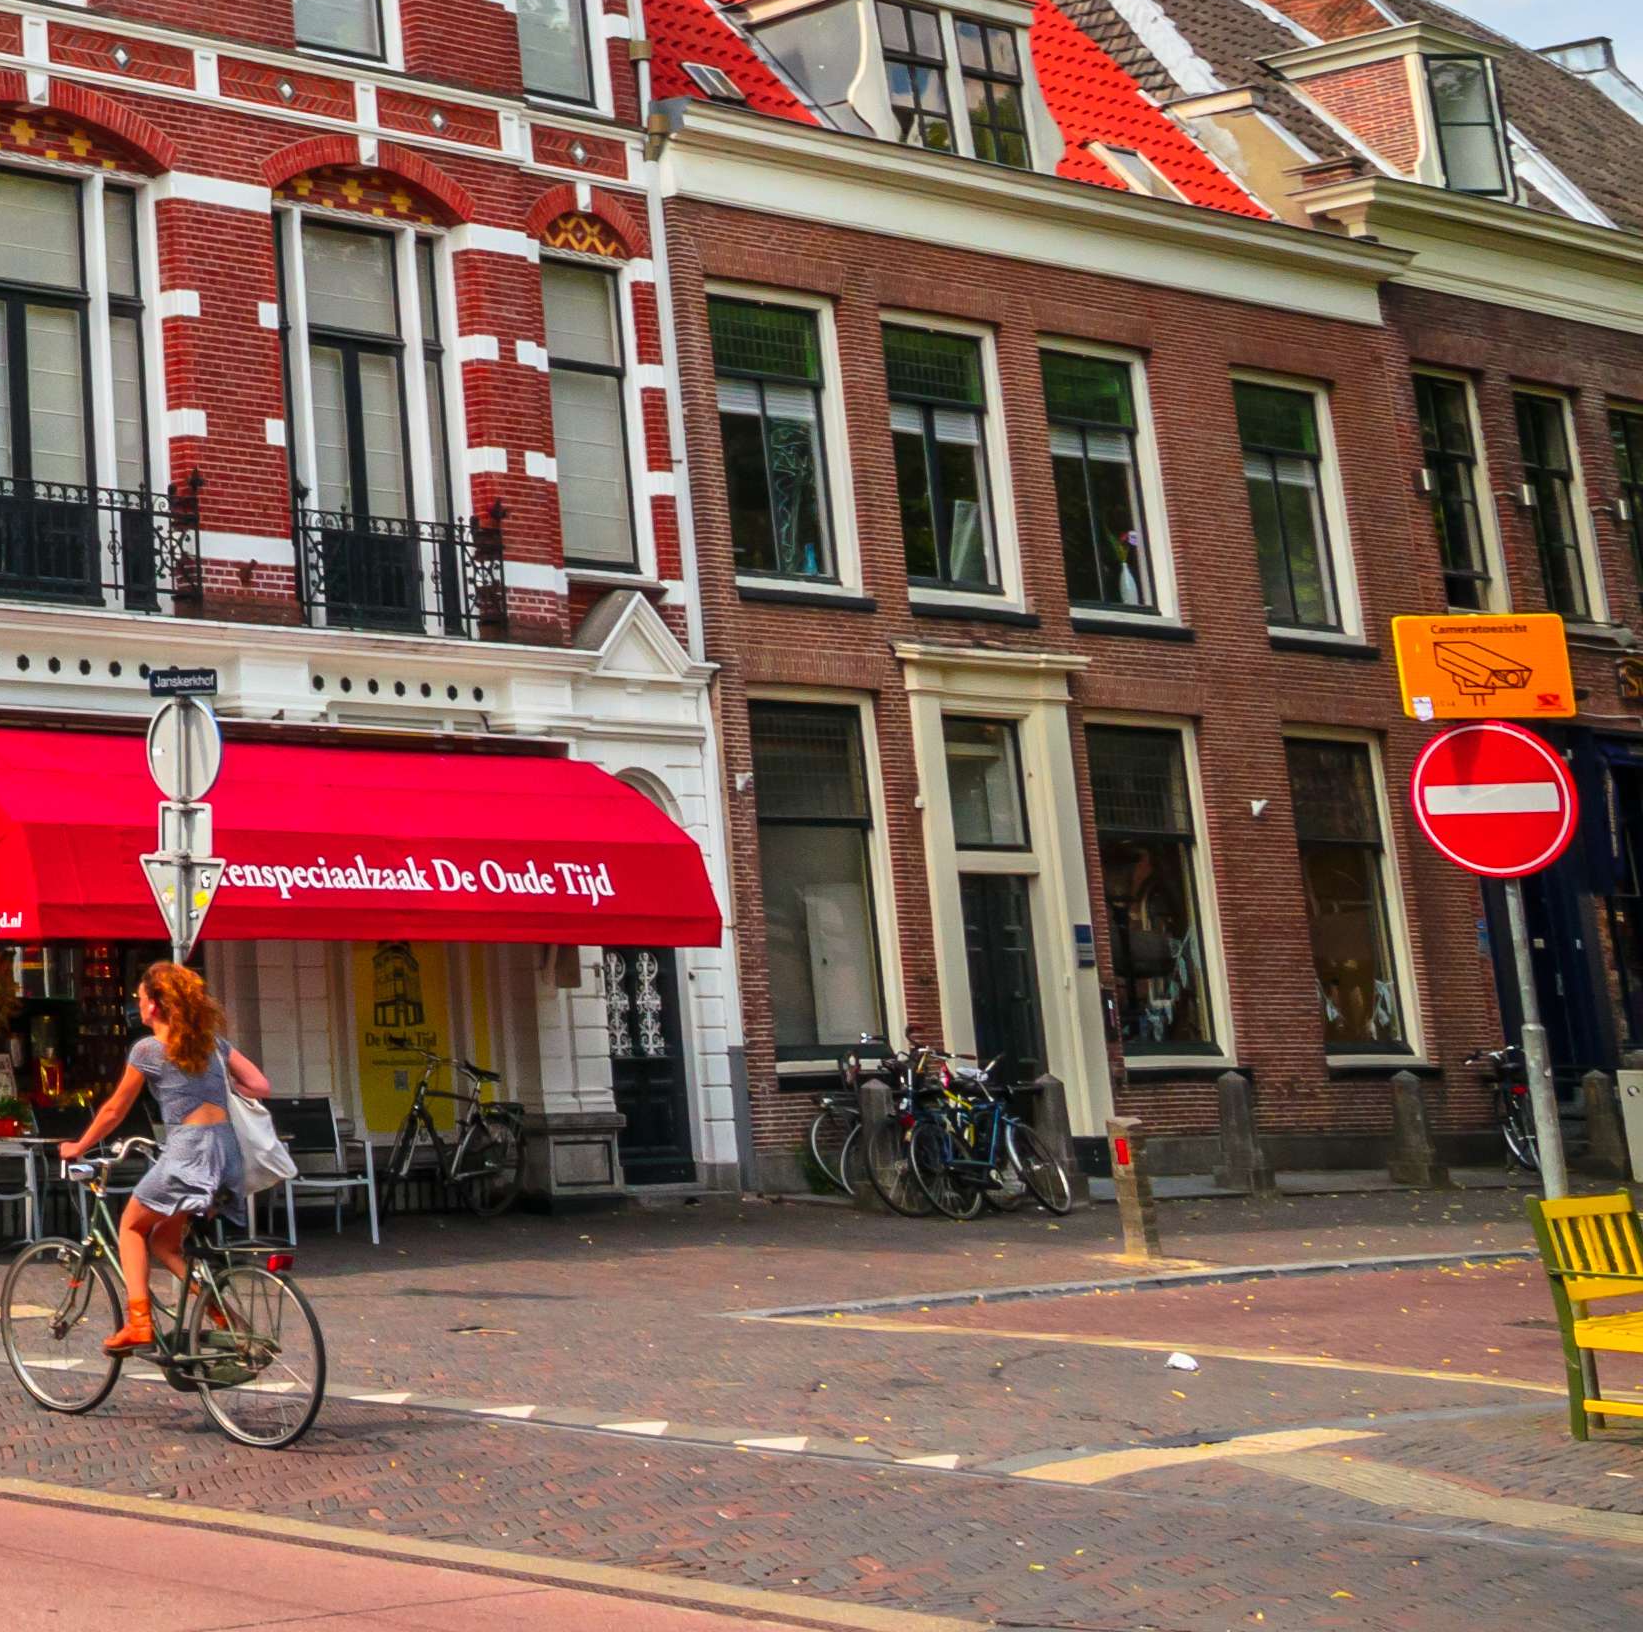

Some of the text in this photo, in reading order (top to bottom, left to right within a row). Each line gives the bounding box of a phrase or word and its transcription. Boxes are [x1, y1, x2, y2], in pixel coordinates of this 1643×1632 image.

[1430, 623, 1528, 635] Cameratoezicht
[154, 673, 215, 688] Janskerkhof
[220, 855, 616, 906] renspeciaalzaak De Oude Tijd
